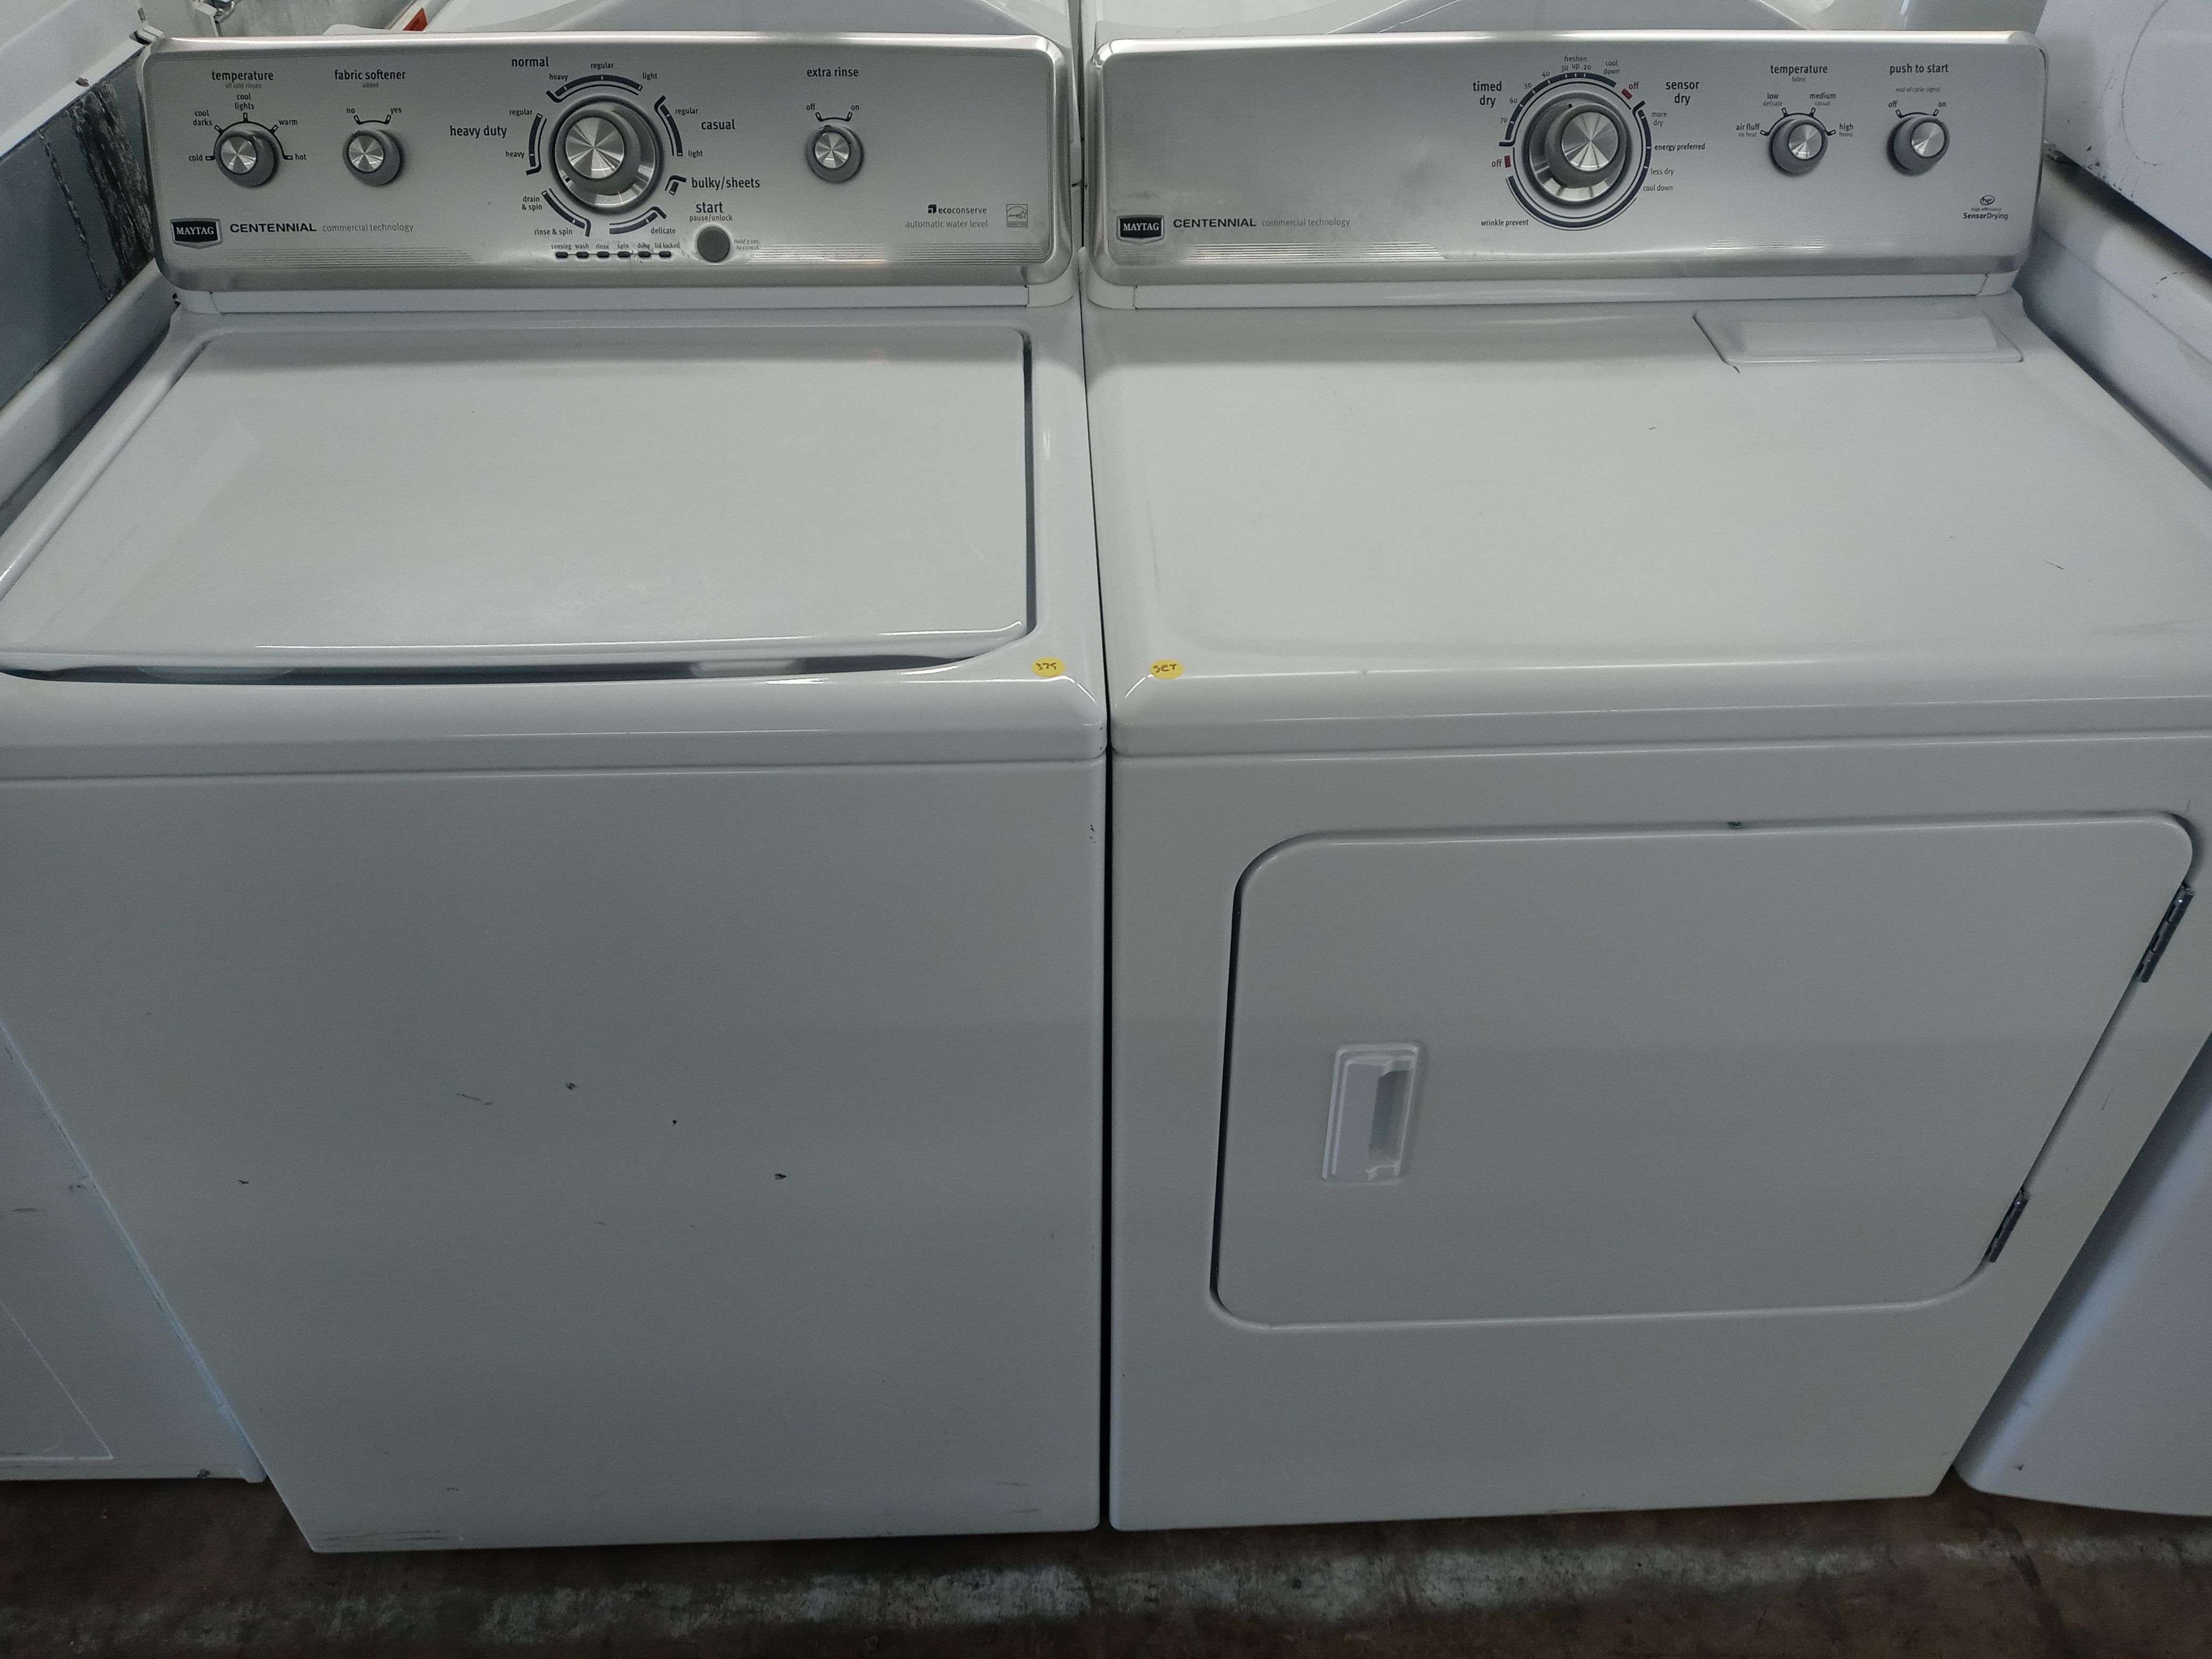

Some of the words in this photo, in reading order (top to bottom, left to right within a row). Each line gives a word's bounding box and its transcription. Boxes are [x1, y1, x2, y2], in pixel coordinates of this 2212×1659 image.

[512, 57, 549, 67] normal
[807, 68, 831, 77] extra
[835, 67, 859, 77] rinse
[1771, 64, 1828, 75] temperature
[1890, 64, 1912, 74] push
[1927, 63, 1948, 73] start
[212, 71, 273, 82] temperature
[335, 70, 363, 80] fabric
[365, 70, 406, 80] softener
[1473, 81, 1502, 92] timed
[1666, 80, 1699, 90] sensor
[1480, 95, 1495, 107] dry
[1674, 93, 1690, 105] dry
[234, 102, 254, 111] lights
[701, 120, 735, 130] casual
[450, 125, 480, 137] heavy
[483, 125, 507, 138] duty
[692, 177, 760, 189] bulky/sheets
[696, 202, 724, 213] start
[689, 214, 733, 222] pause/unlock
[1174, 218, 1256, 228] CENTENNIAL
[1308, 217, 1351, 227] technology
[177, 227, 214, 235] MAYTAG
[230, 223, 316, 232] CENTENNIAL
[370, 223, 413, 233] technology
[559, 228, 573, 237] spin
